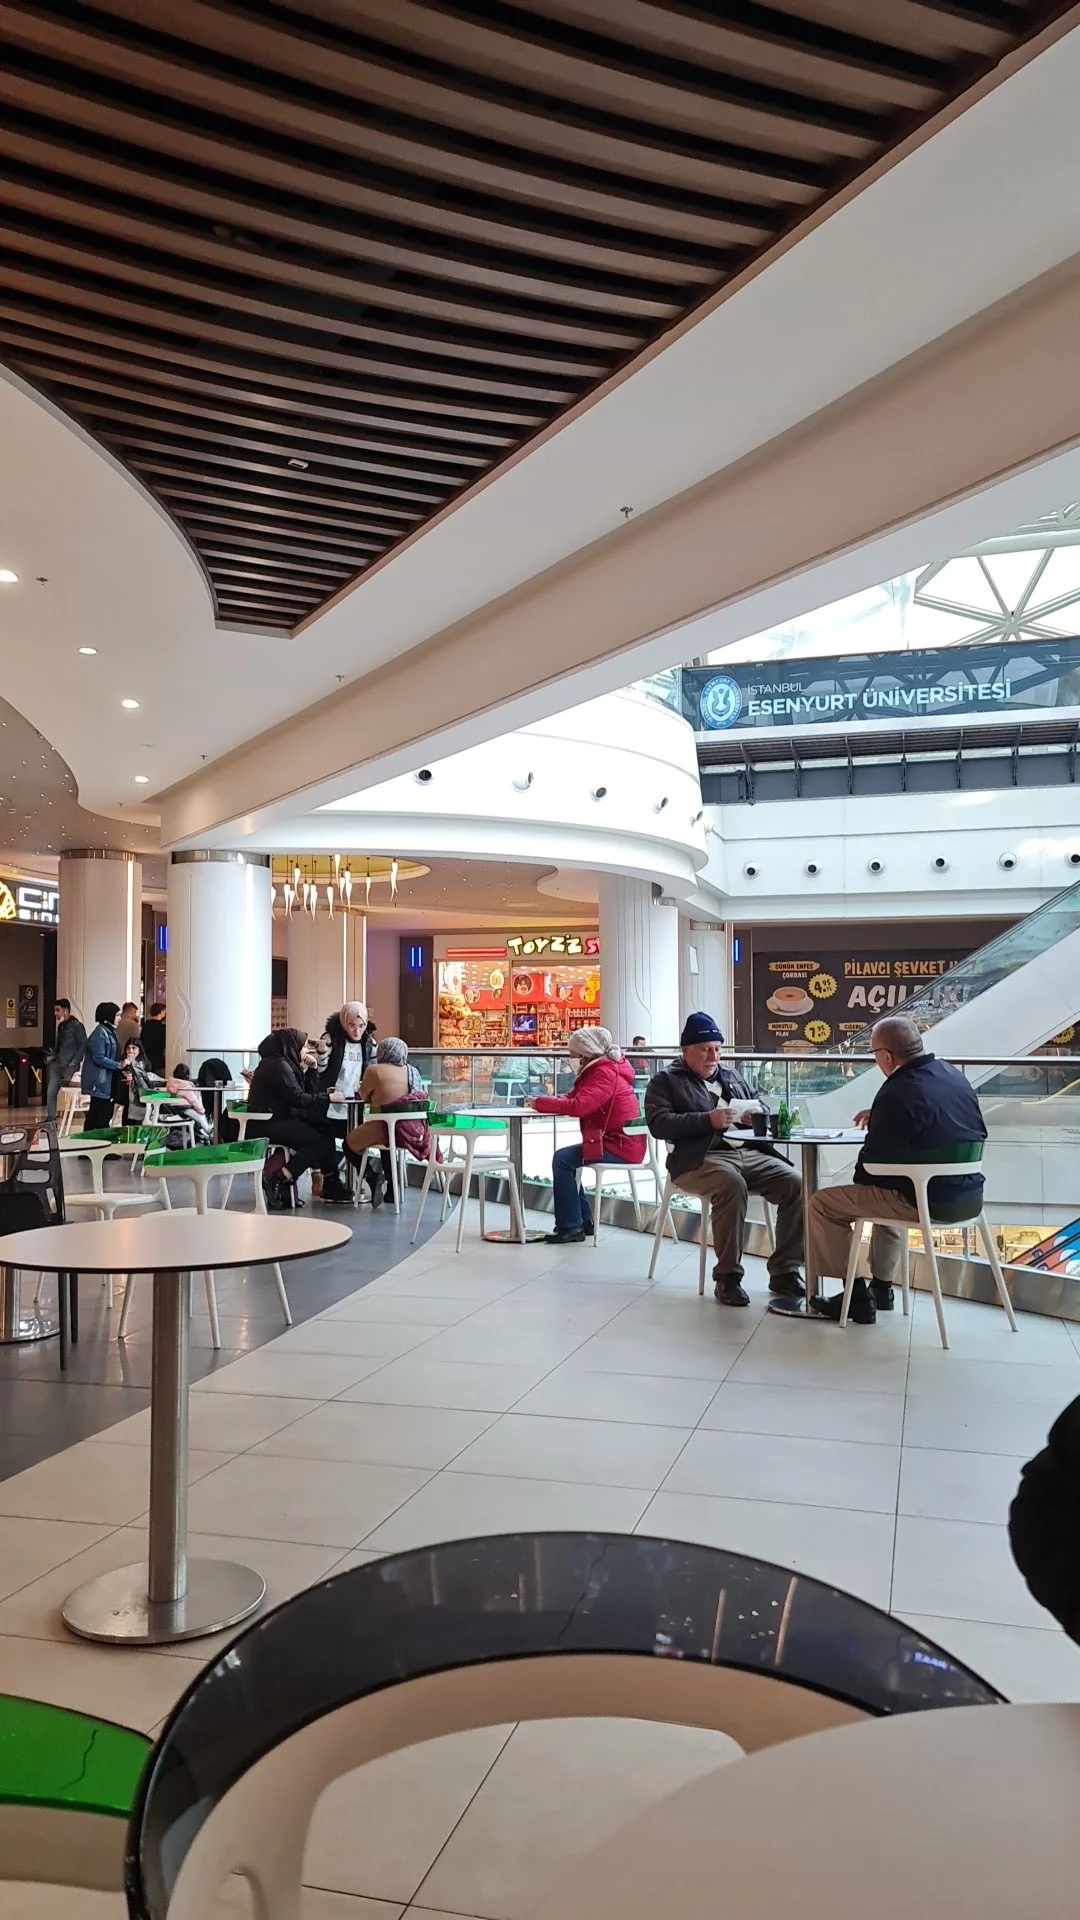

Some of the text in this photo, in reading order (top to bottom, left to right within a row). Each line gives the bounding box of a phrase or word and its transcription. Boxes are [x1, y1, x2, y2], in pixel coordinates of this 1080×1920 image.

[747, 682, 805, 695] İSTANBUL
[748, 678, 1011, 716] ESENYURT ÜNİVERSİTESİ
[844, 958, 891, 975] PİLAVCI
[893, 960, 945, 978] ŞEVKET
